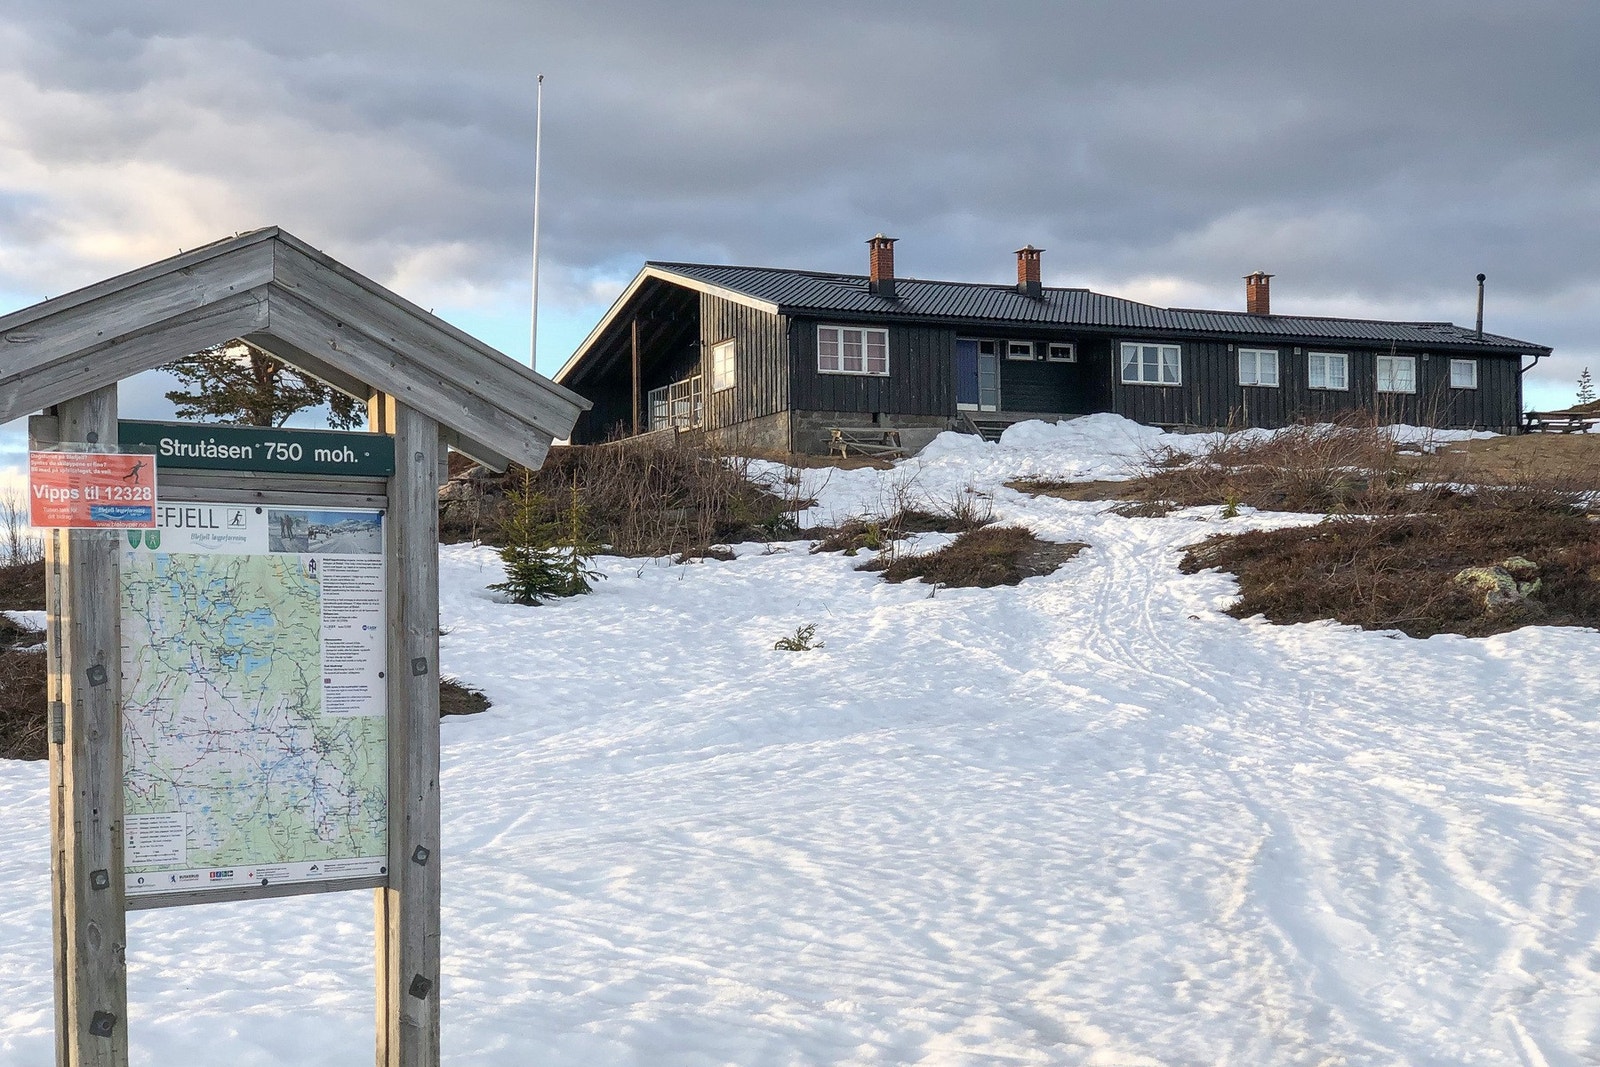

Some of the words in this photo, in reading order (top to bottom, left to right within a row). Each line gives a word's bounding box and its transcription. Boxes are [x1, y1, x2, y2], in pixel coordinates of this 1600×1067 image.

[159, 437, 253, 459] Strutåsen
[263, 442, 303, 461] 750
[314, 446, 359, 463] moh.
[32, 484, 80, 503] Vipps
[84, 485, 100, 500] til
[104, 486, 152, 501] 12328
